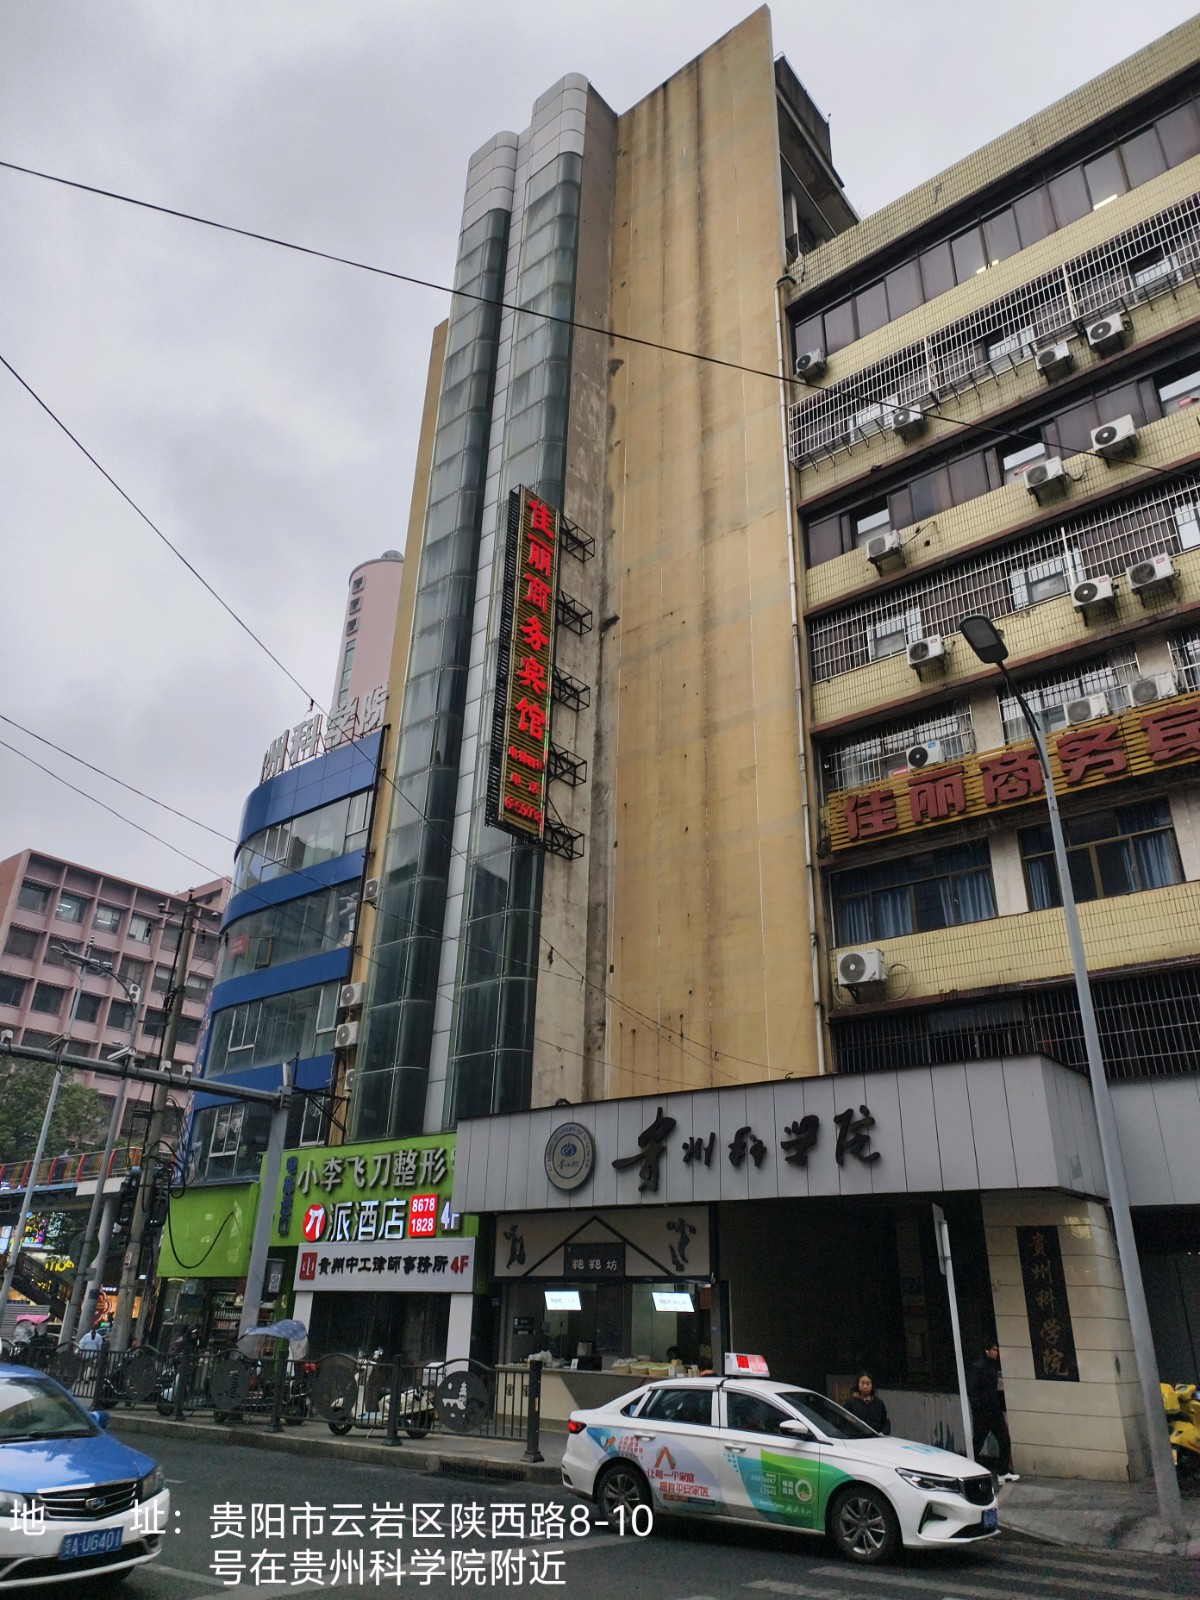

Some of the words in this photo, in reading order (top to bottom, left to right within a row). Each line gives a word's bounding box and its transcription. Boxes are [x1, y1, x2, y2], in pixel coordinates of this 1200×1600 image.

[515, 499, 555, 741] 佳丽商务宾馆
[298, 1147, 455, 1194] 小李飞刀整形
[412, 1198, 435, 1212] 8678
[411, 1217, 434, 1232] 1828
[450, 1256, 469, 1273] 4F
